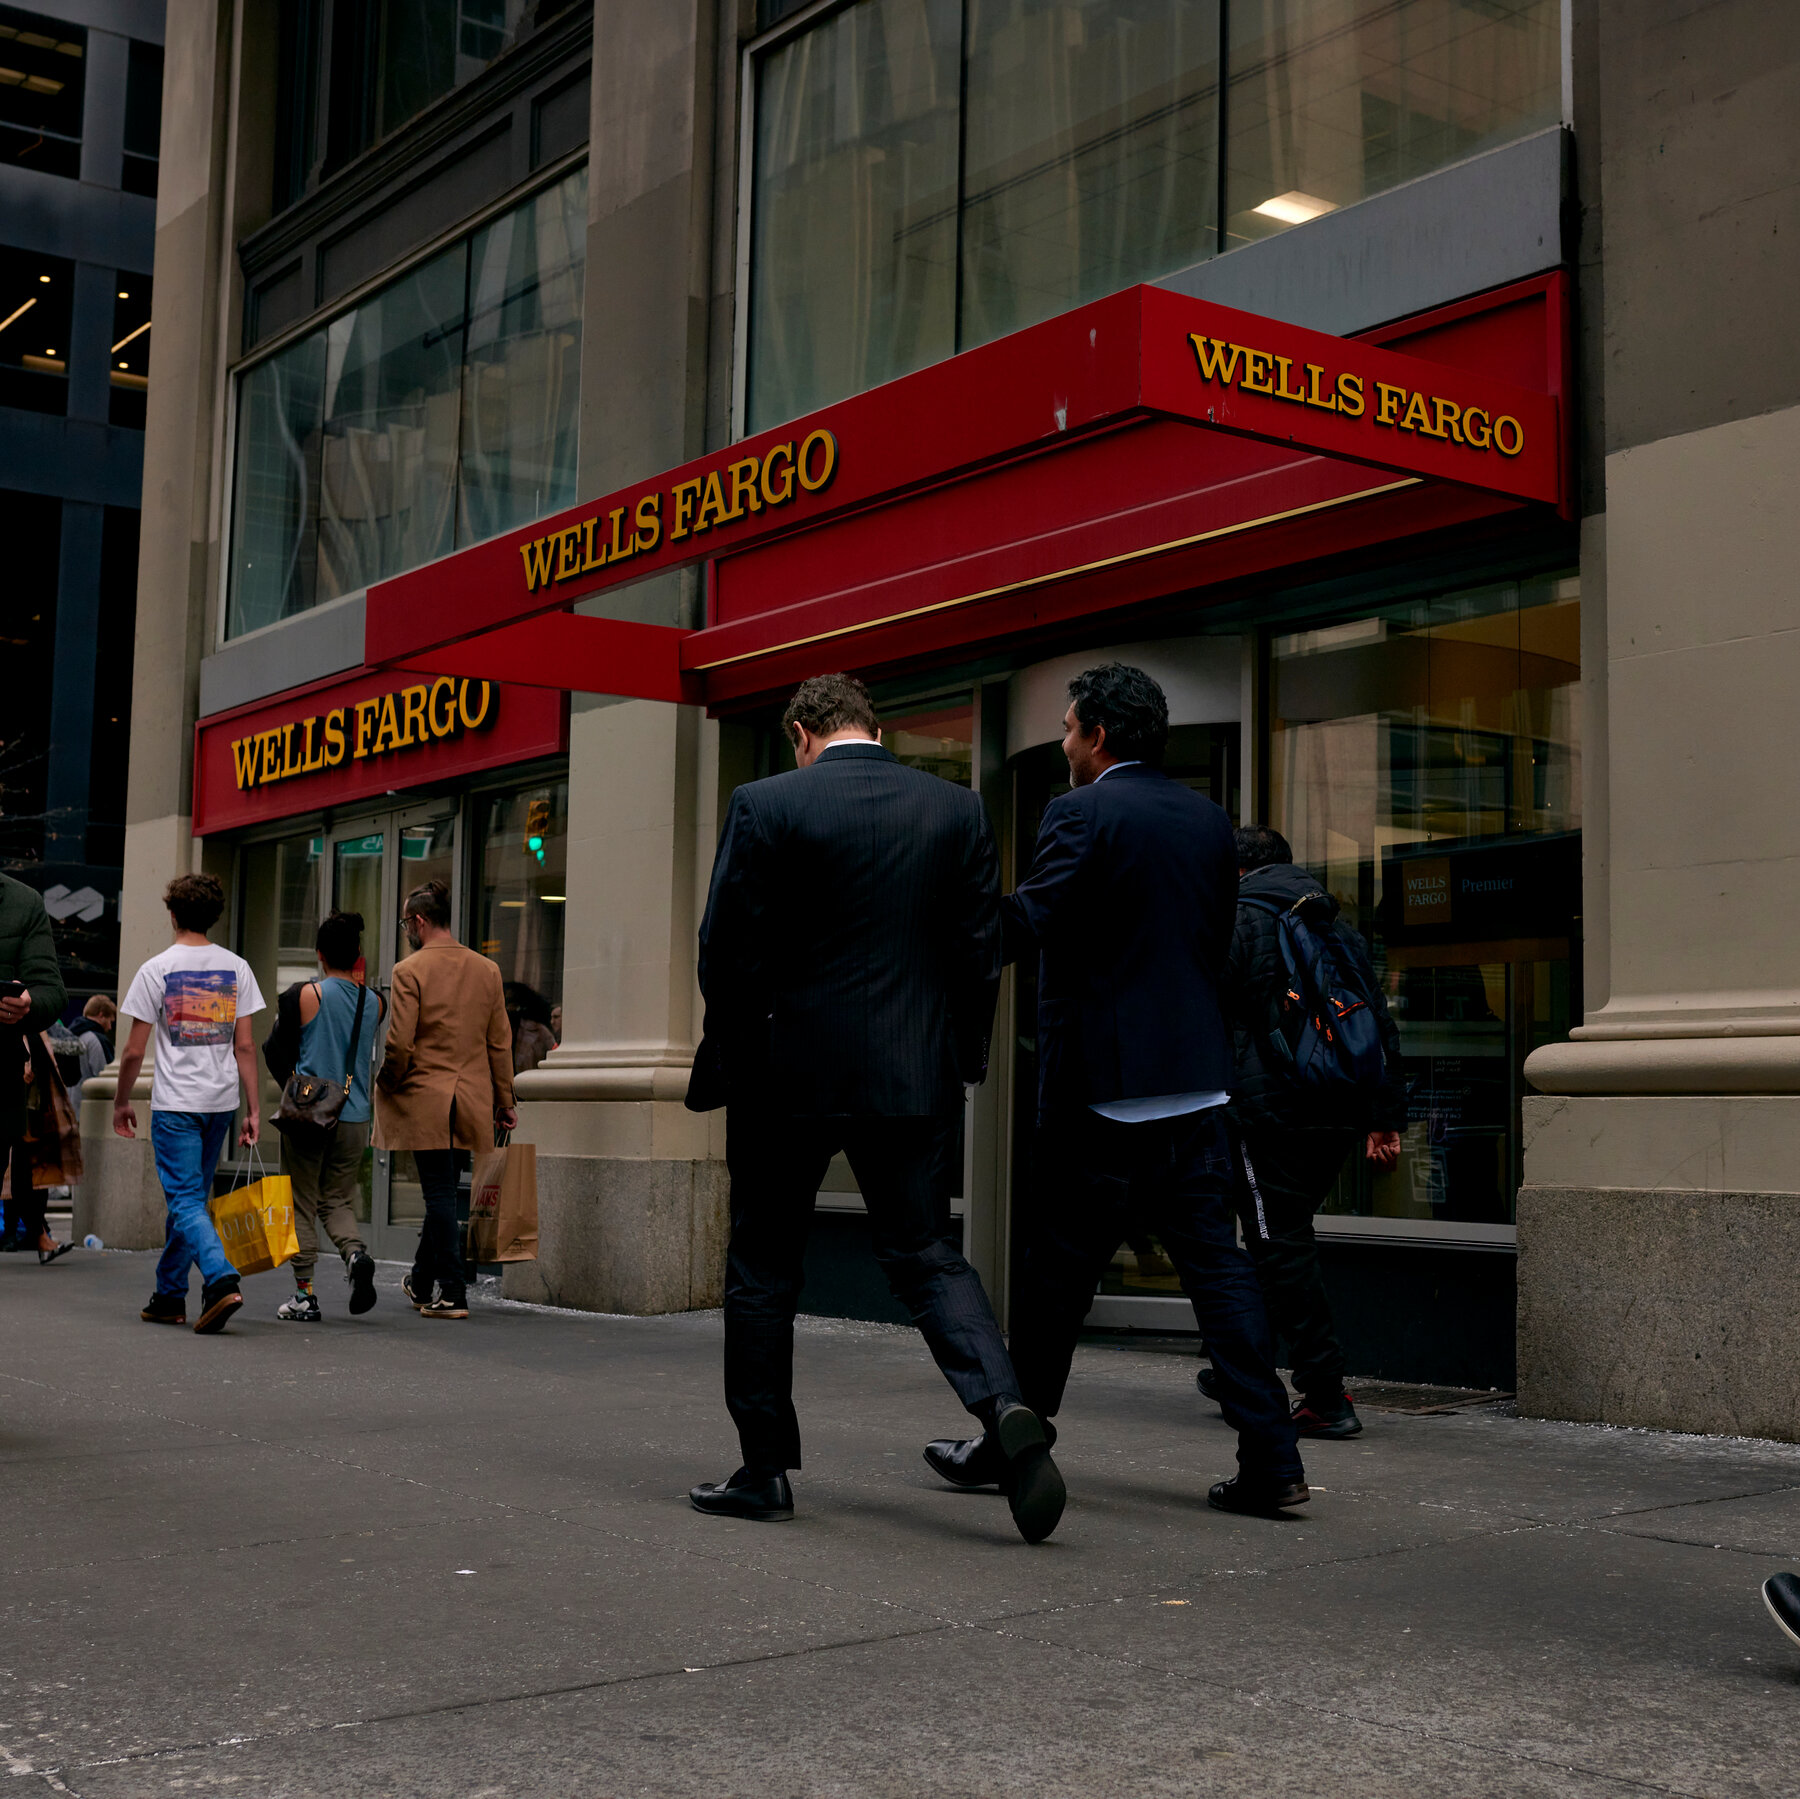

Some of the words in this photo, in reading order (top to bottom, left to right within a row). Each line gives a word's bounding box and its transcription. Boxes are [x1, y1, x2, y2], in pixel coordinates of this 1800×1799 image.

[1187, 333, 1366, 417] WELLS
[1374, 381, 1525, 457] FARGO
[520, 493, 663, 592] WELLS
[670, 429, 838, 543] FARGO
[231, 708, 347, 791] WELLS
[353, 676, 492, 760] FARGO
[1406, 876, 1447, 891] WELLS
[1407, 891, 1447, 907] FARGO
[1461, 877, 1515, 894] Premier
